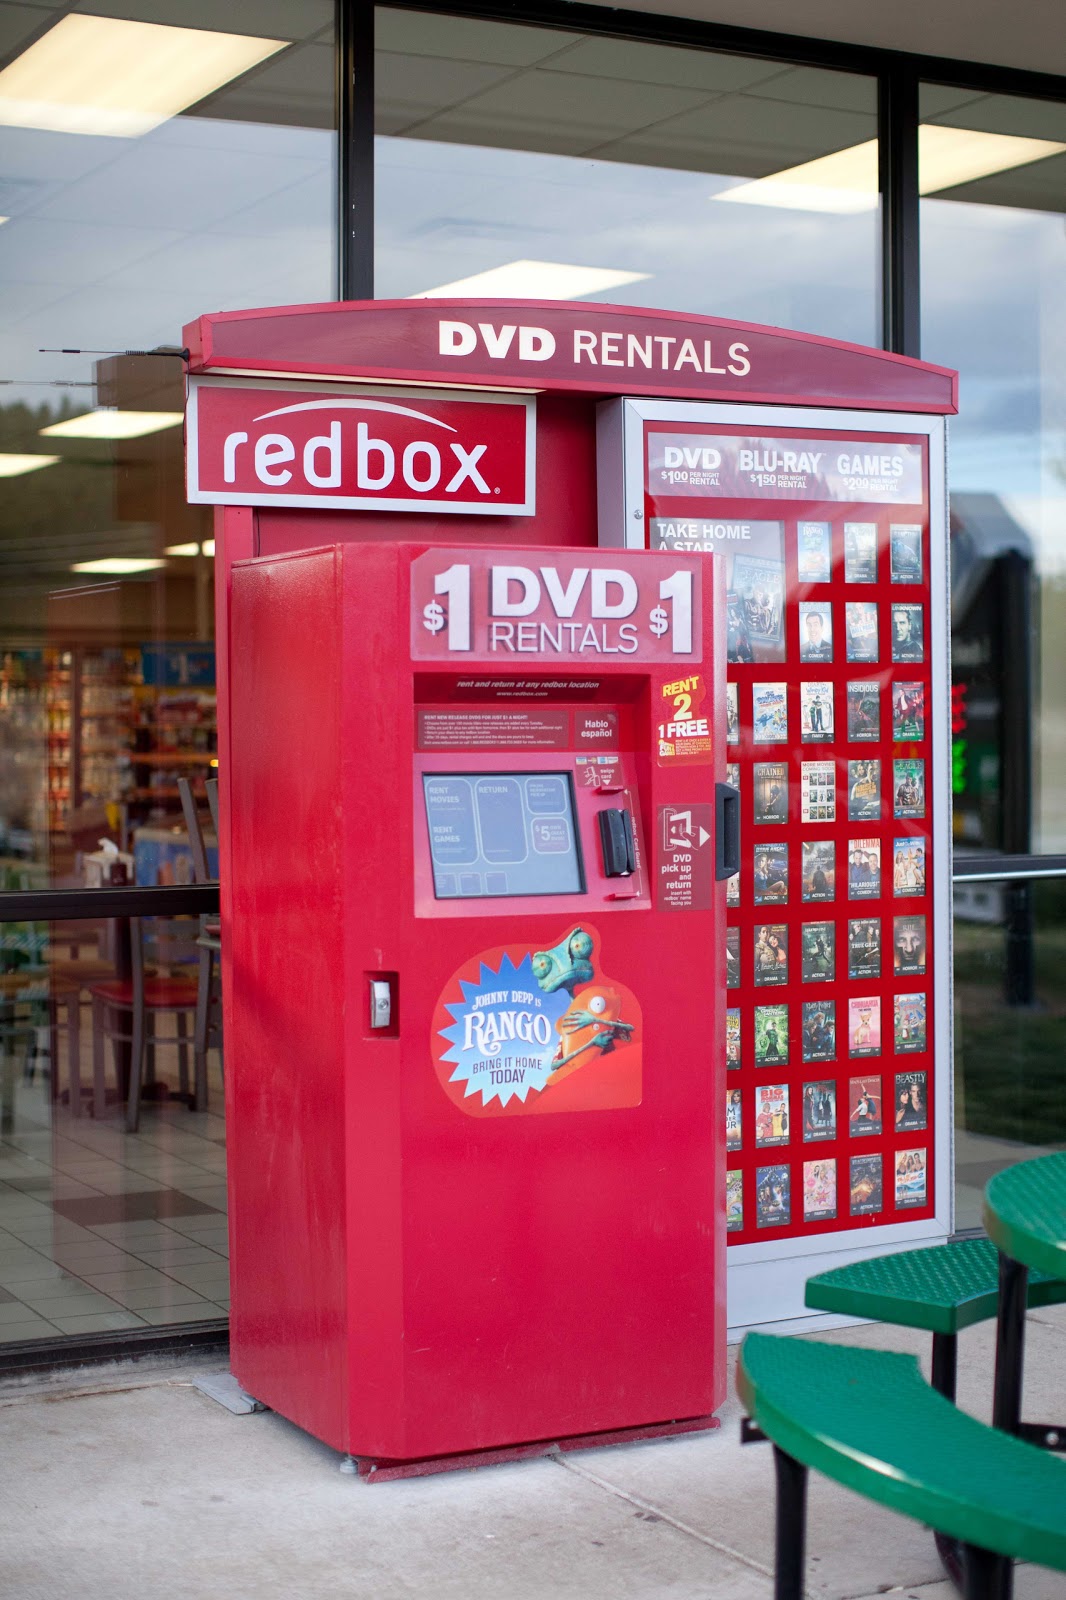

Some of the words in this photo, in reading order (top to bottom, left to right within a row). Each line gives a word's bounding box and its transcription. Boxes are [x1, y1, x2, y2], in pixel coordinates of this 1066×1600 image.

[439, 320, 556, 361] DVD
[574, 330, 750, 376] RENTALS
[224, 420, 492, 494] redbox
[664, 446, 722, 470] DVD
[740, 450, 822, 474] BLU-RAY
[837, 454, 904, 476] GAMES
[657, 524, 698, 538] TAKE
[702, 524, 751, 539] HOME
[674, 542, 714, 552] STAR
[422, 564, 470, 650] $1
[491, 566, 638, 619] DVD
[649, 570, 692, 653] $1
[491, 622, 638, 654] RENTALS
[662, 676, 699, 697] RENT
[674, 693, 692, 721] 2
[581, 729, 612, 738] español
[658, 724, 664, 738] 1
[667, 719, 709, 738] FREE
[758, 768, 784, 776] CHAINED
[854, 838, 880, 848] DILEMMA
[673, 854, 692, 862] DVD
[662, 864, 678, 874] pick
[681, 865, 692, 873] up
[666, 881, 692, 889] return
[472, 990, 508, 1010] JOHNNY
[512, 990, 534, 1005] DEPP
[534, 998, 542, 1007] IS
[462, 1011, 552, 1056] RANGO
[473, 1057, 502, 1074] BRING
[504, 1057, 512, 1068] IT
[515, 1057, 542, 1070] HOME
[490, 1069, 526, 1085] TODAY
[895, 1073, 926, 1084] BEASTLY
